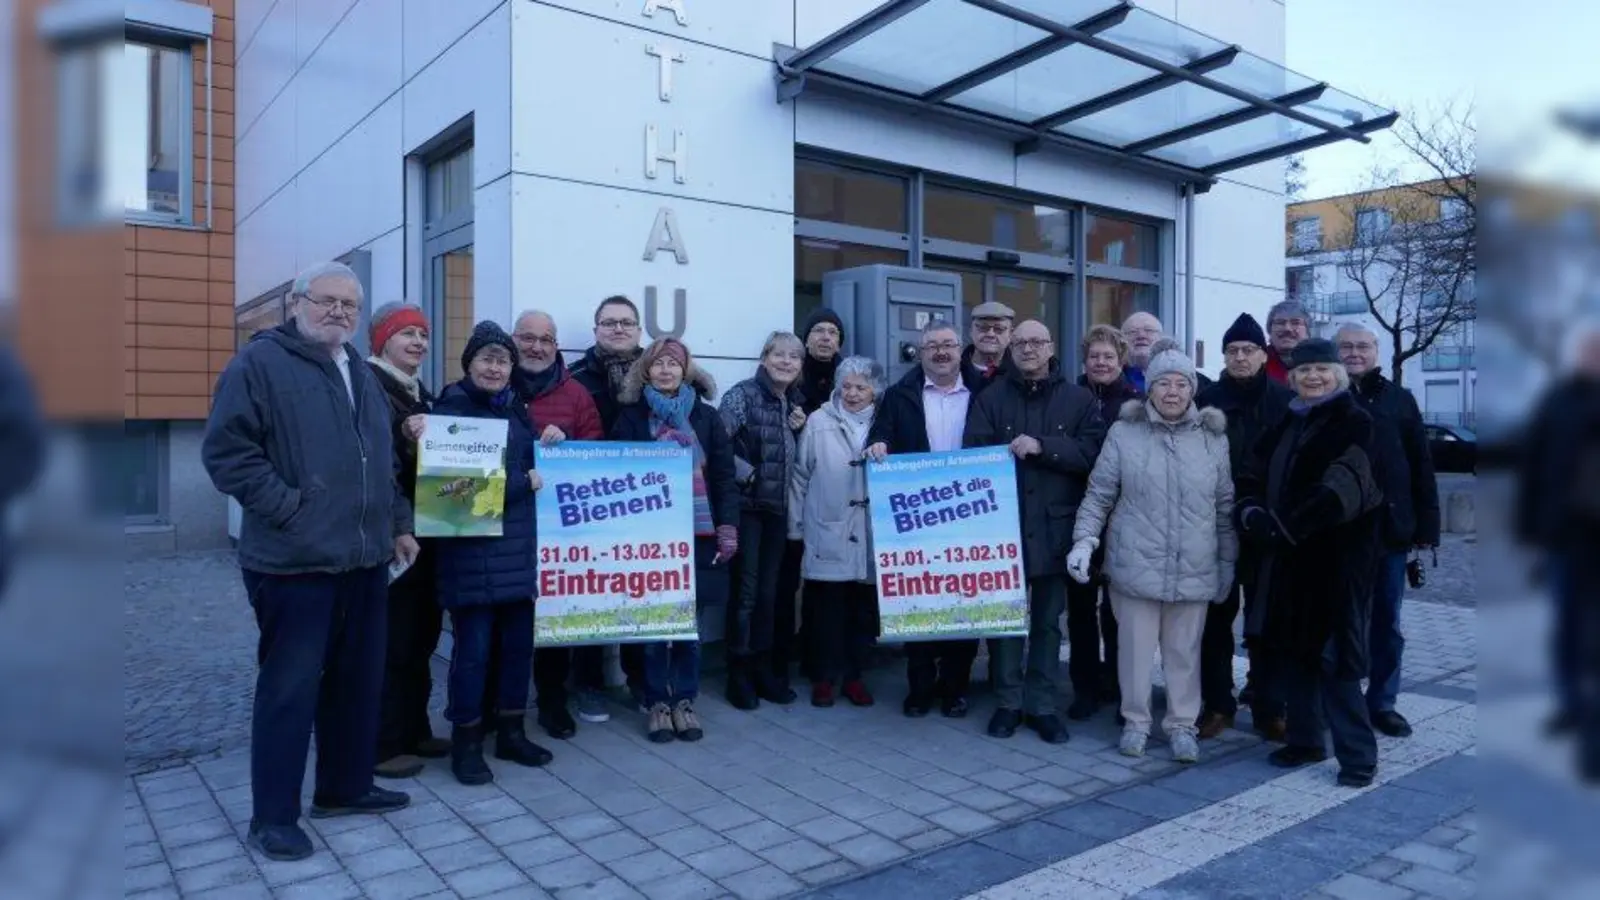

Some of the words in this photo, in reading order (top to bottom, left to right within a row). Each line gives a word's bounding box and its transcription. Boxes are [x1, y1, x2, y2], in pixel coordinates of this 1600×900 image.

[425, 440, 499, 454] Bienengifte?
[556, 472, 638, 503] Rettet
[641, 471, 667, 487] die
[889, 480, 964, 513] Rettet
[967, 477, 992, 493] die
[559, 485, 673, 527] Bienen!
[893, 489, 999, 534] Bienen!
[540, 546, 597, 563] 31.01.
[612, 542, 690, 561] 13.02.19
[879, 550, 931, 568] 31.01.
[944, 543, 1018, 563] 13.02.19
[540, 563, 690, 599] Eintragen!
[881, 564, 1021, 598] Eintragen!
